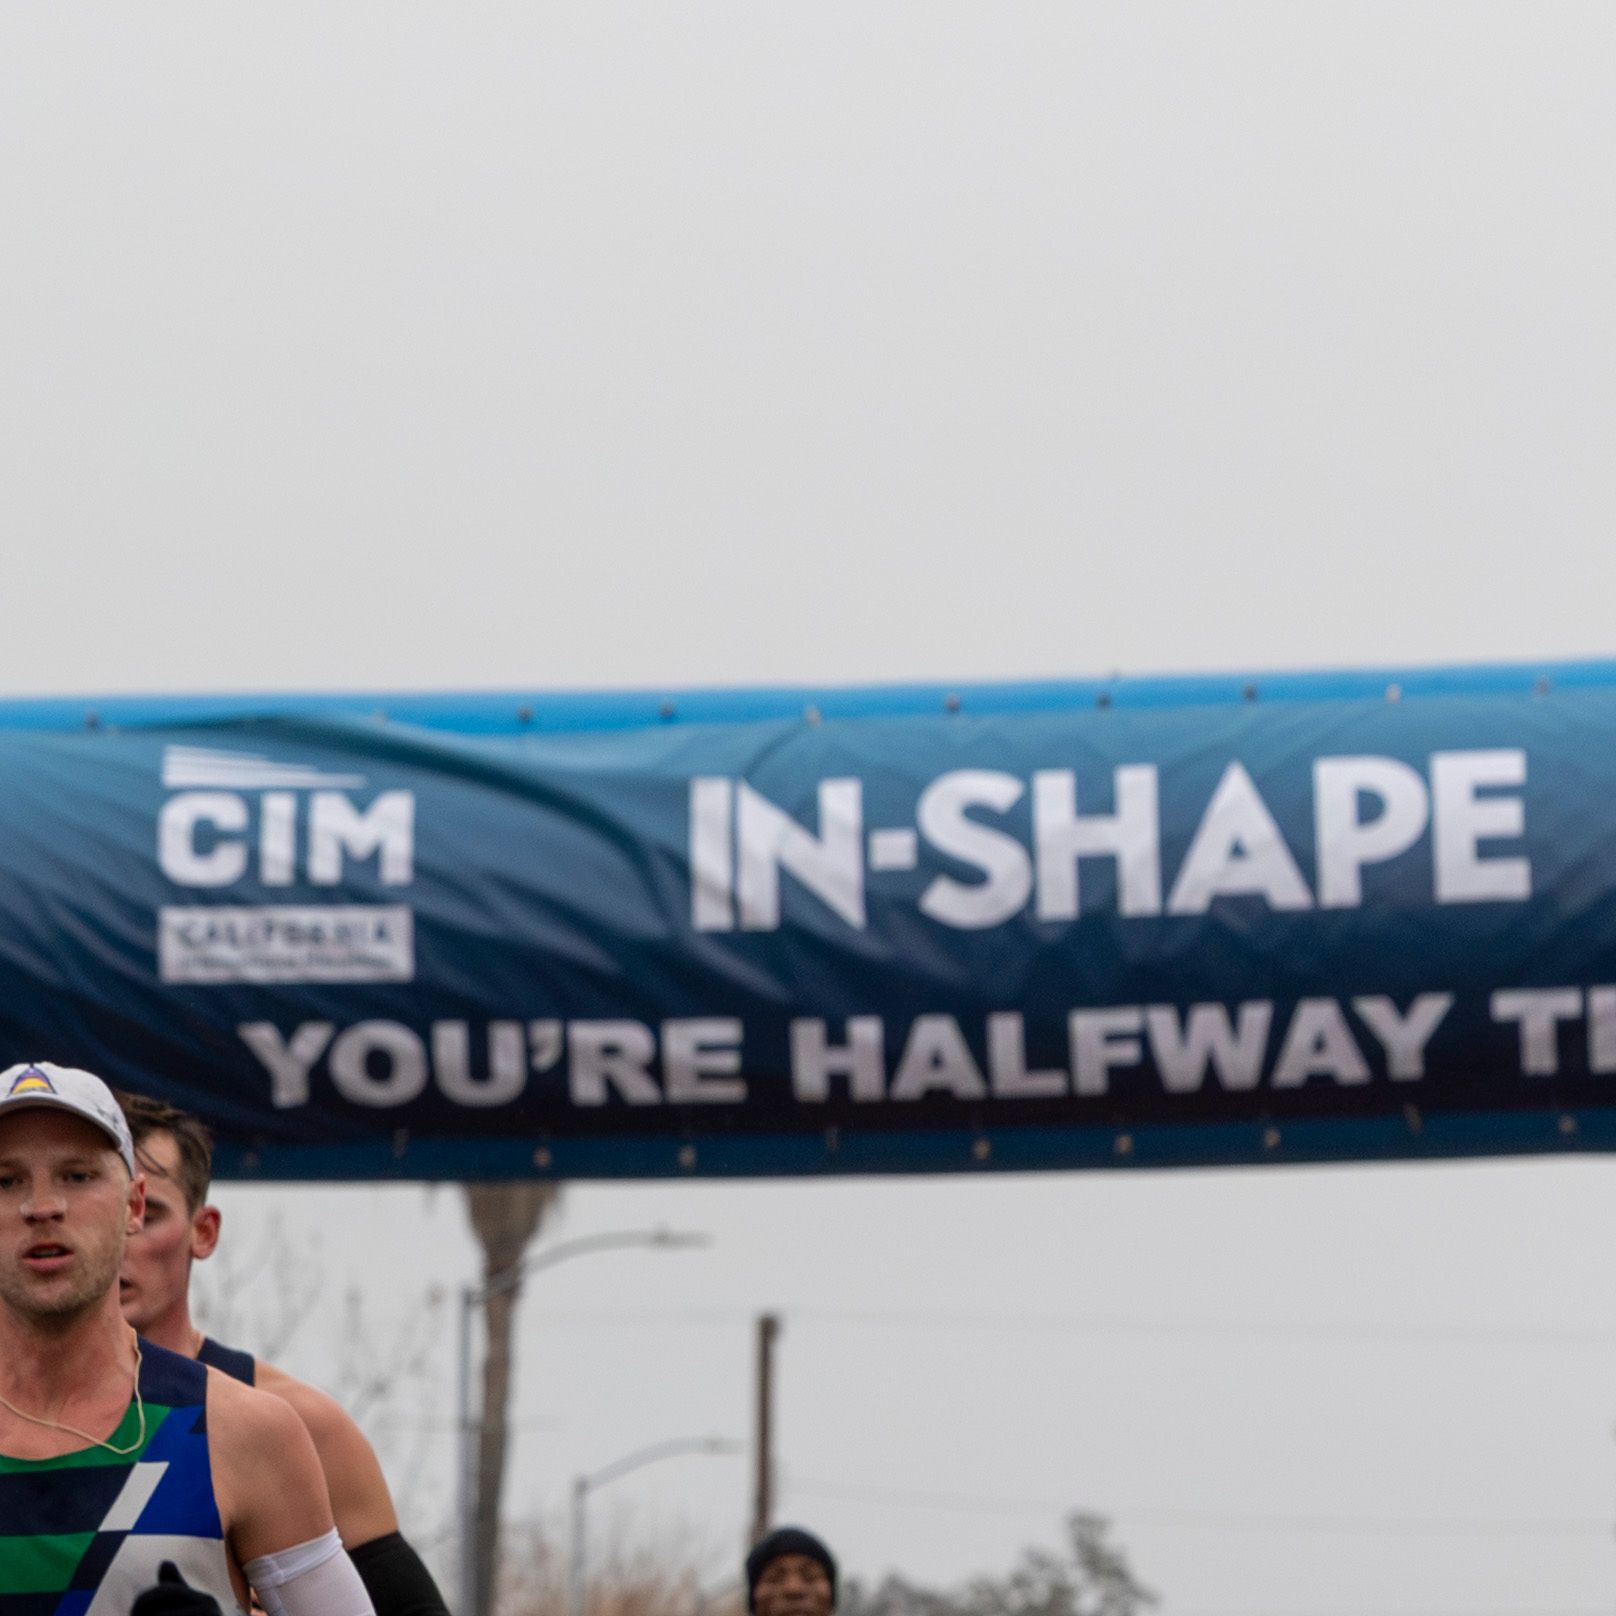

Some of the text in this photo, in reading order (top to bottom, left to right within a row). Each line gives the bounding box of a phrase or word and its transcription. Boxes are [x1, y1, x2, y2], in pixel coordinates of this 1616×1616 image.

[158, 789, 416, 888] CIM
[689, 748, 1533, 933] IN-SHAPE
[236, 1017, 748, 1110] YOU'RE
[789, 991, 1455, 1103] HALFWAY
